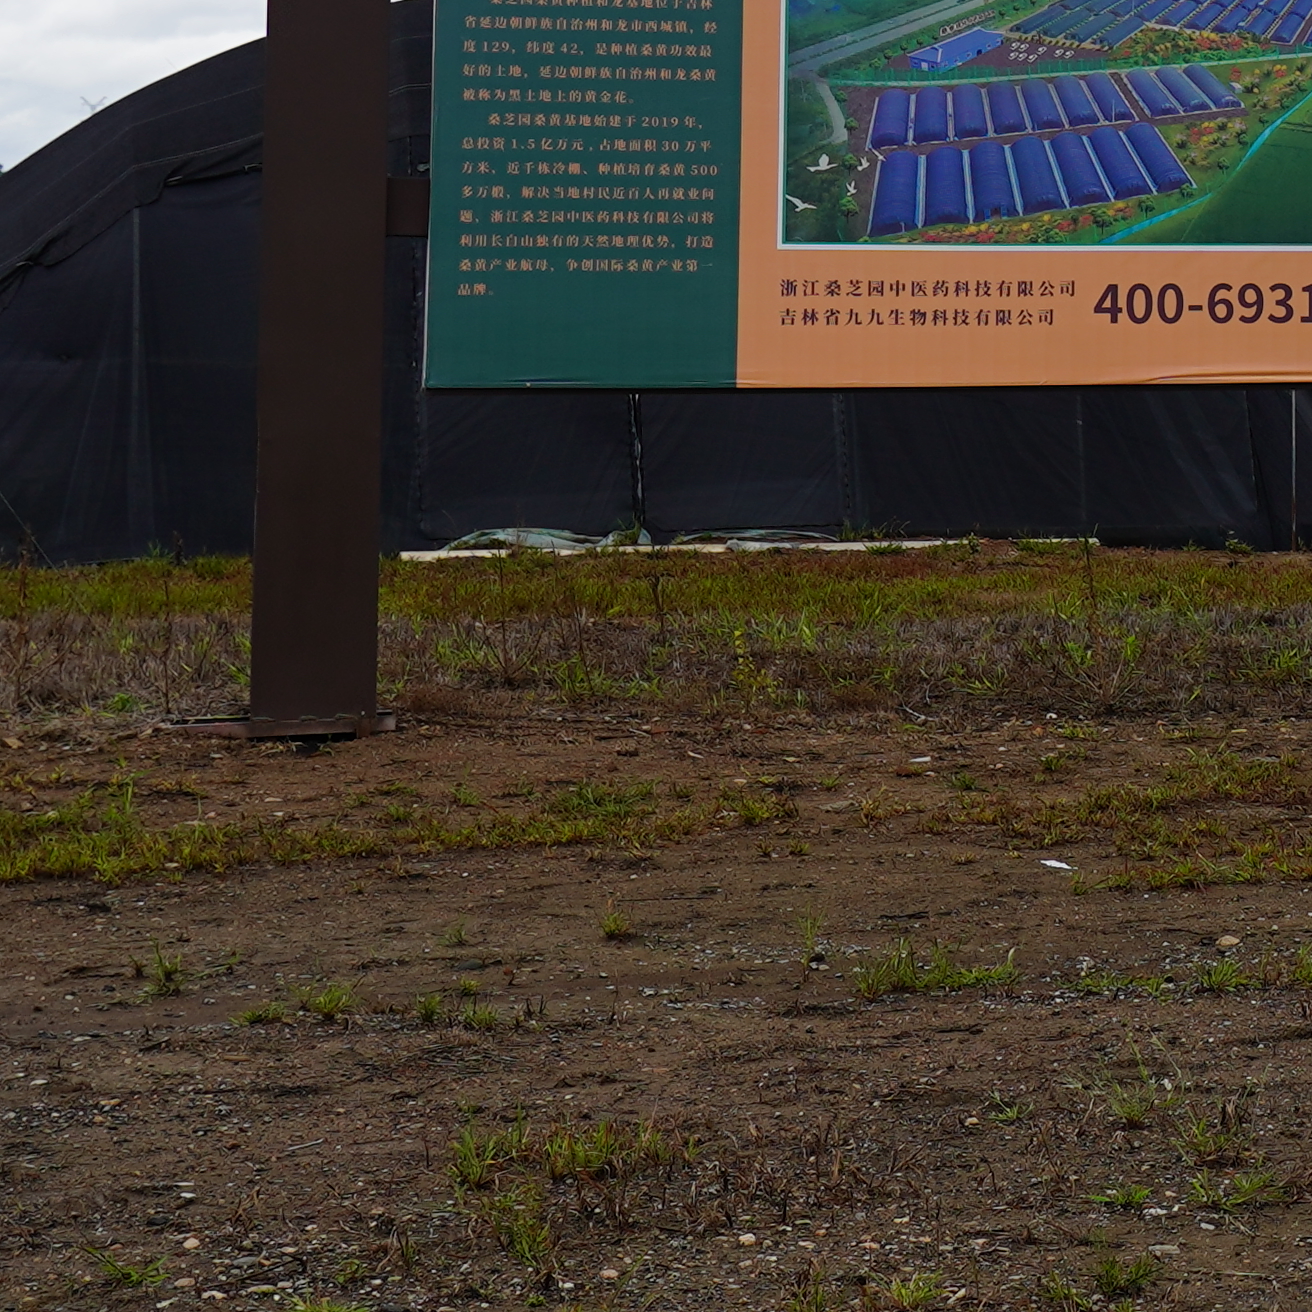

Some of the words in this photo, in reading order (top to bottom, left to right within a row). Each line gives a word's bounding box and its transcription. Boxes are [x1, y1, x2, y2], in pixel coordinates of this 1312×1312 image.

[780, 279, 1076, 298] 浙江桑芝园中医药科技有限公司
[779, 308, 1055, 327] 吉林省九九生物科技有限公司
